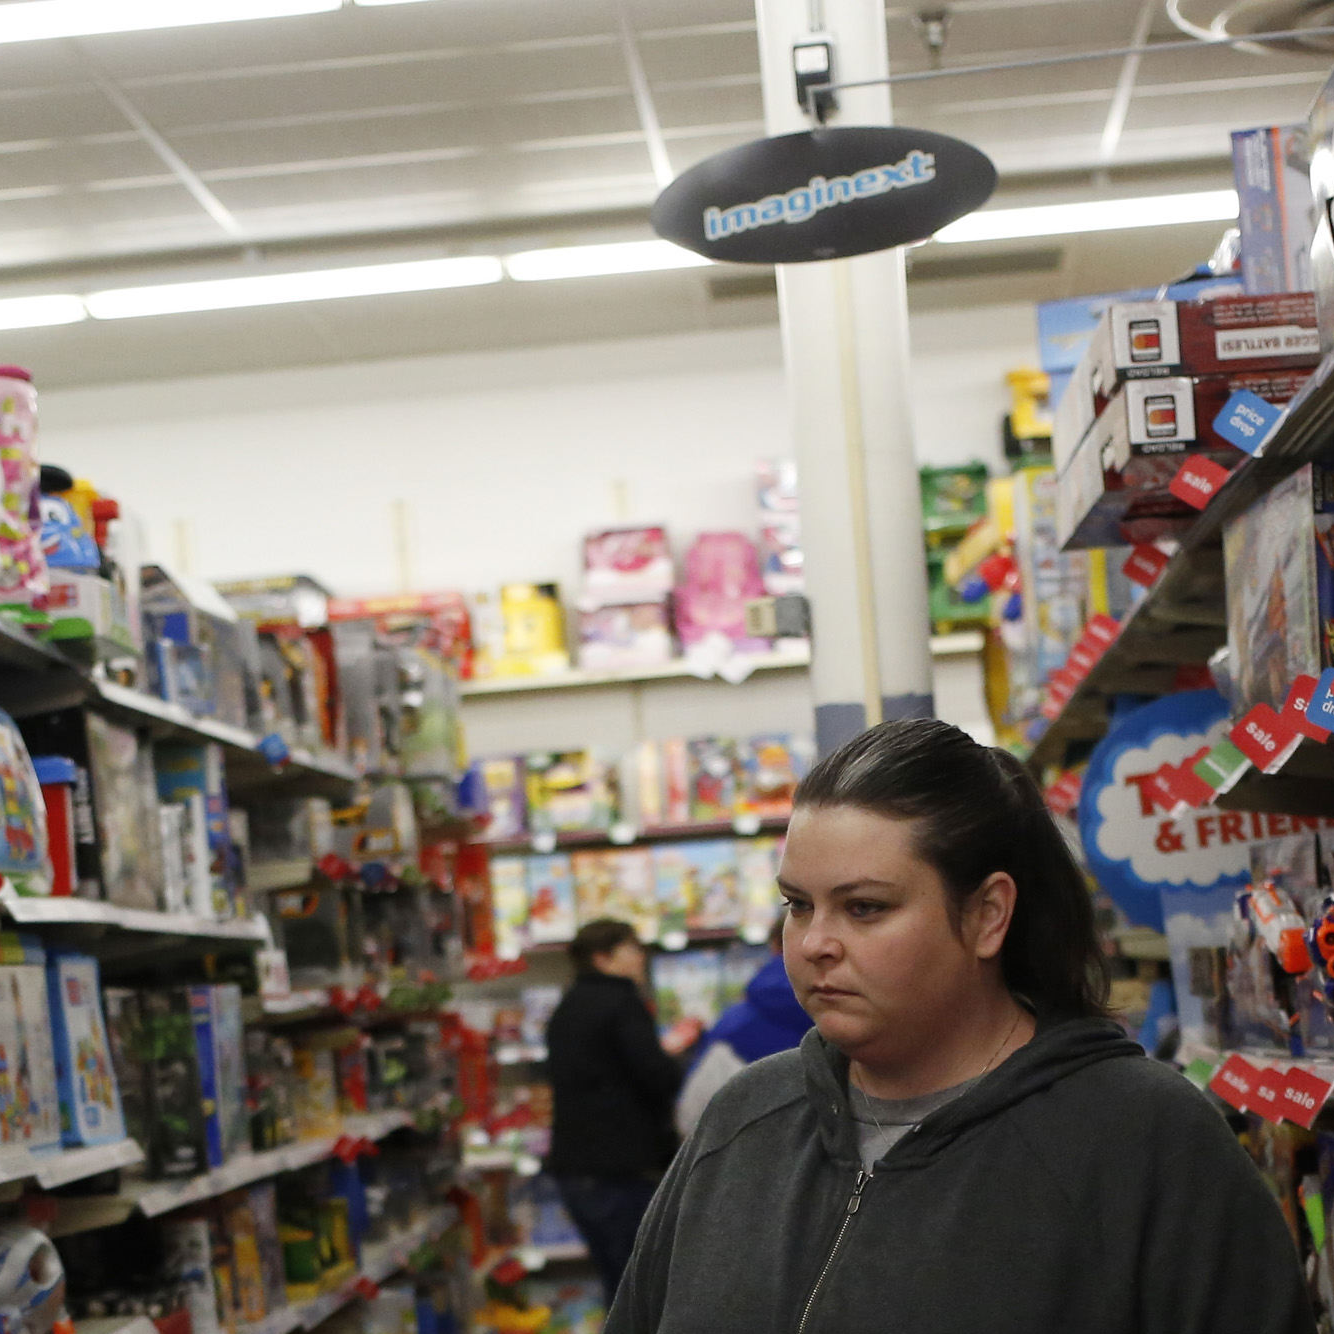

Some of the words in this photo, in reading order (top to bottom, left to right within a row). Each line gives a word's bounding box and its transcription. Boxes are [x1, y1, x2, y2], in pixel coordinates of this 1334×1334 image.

[702, 150, 935, 241] imaginext
[1229, 415, 1255, 438] drop
[1234, 402, 1265, 427] price
[1183, 471, 1212, 495] sale
[1244, 720, 1277, 752] sale
[1155, 820, 1186, 852] &
[1222, 1070, 1250, 1094] sale
[1284, 1087, 1315, 1110] sale
